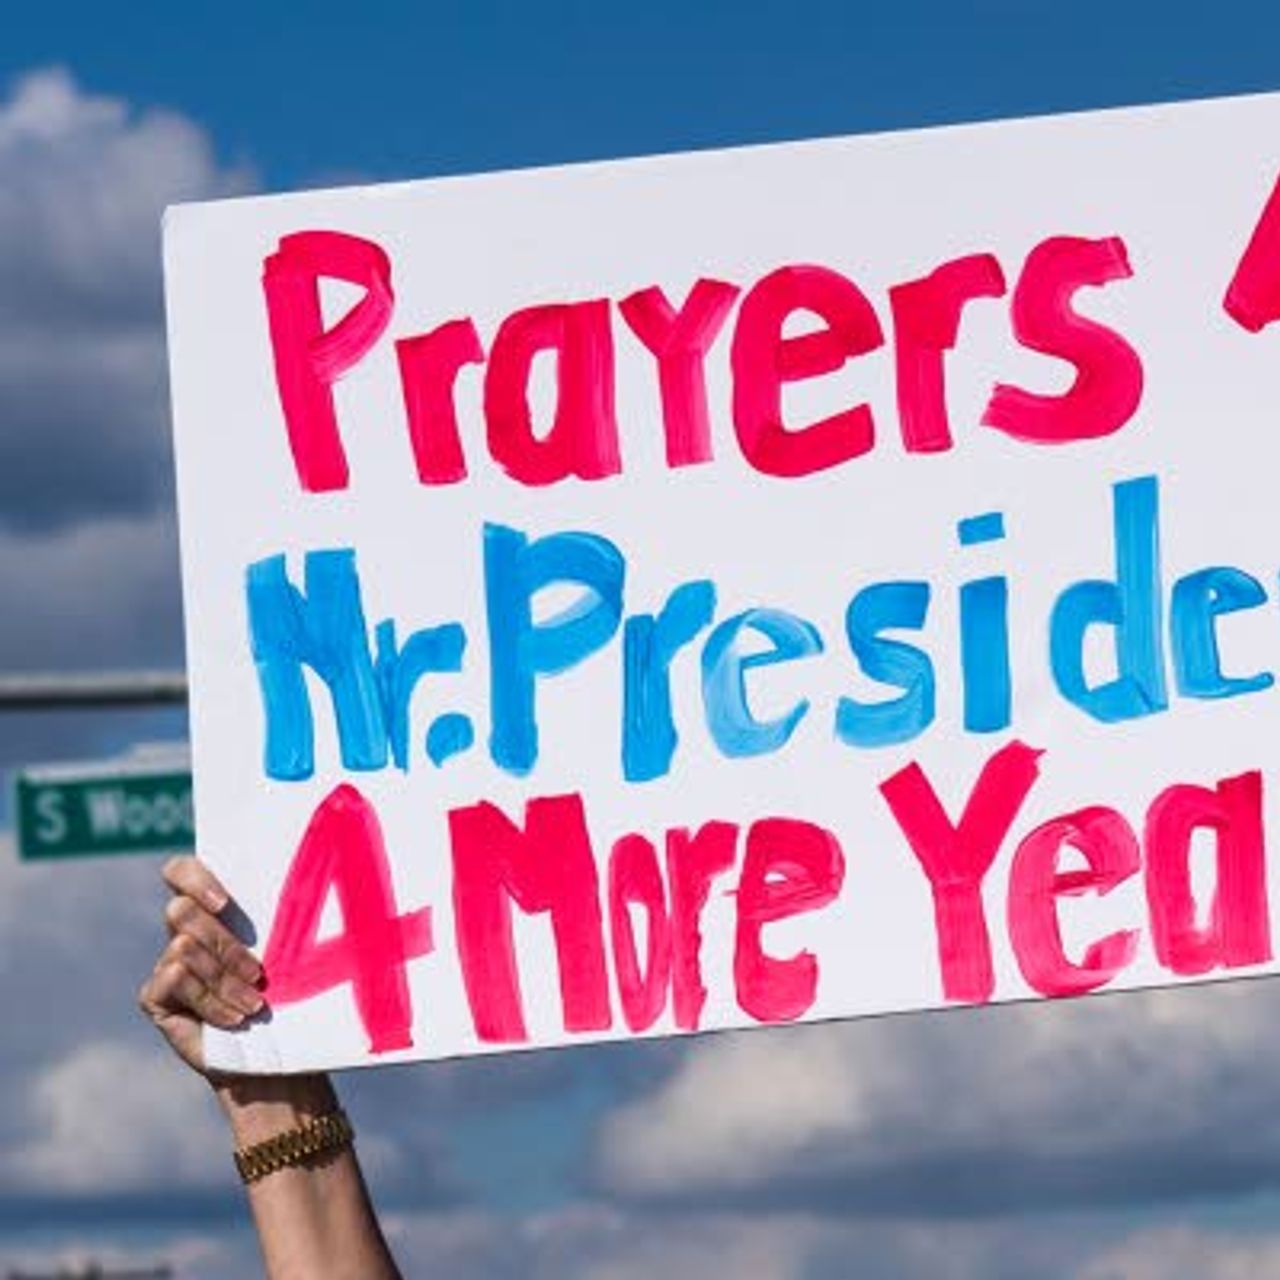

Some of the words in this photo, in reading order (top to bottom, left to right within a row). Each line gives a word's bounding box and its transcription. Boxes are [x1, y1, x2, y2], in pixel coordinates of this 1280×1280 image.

[262, 230, 1143, 493] Prayers
[36, 789, 67, 841] S
[257, 783, 433, 1054] 4
[448, 793, 846, 1042] More
